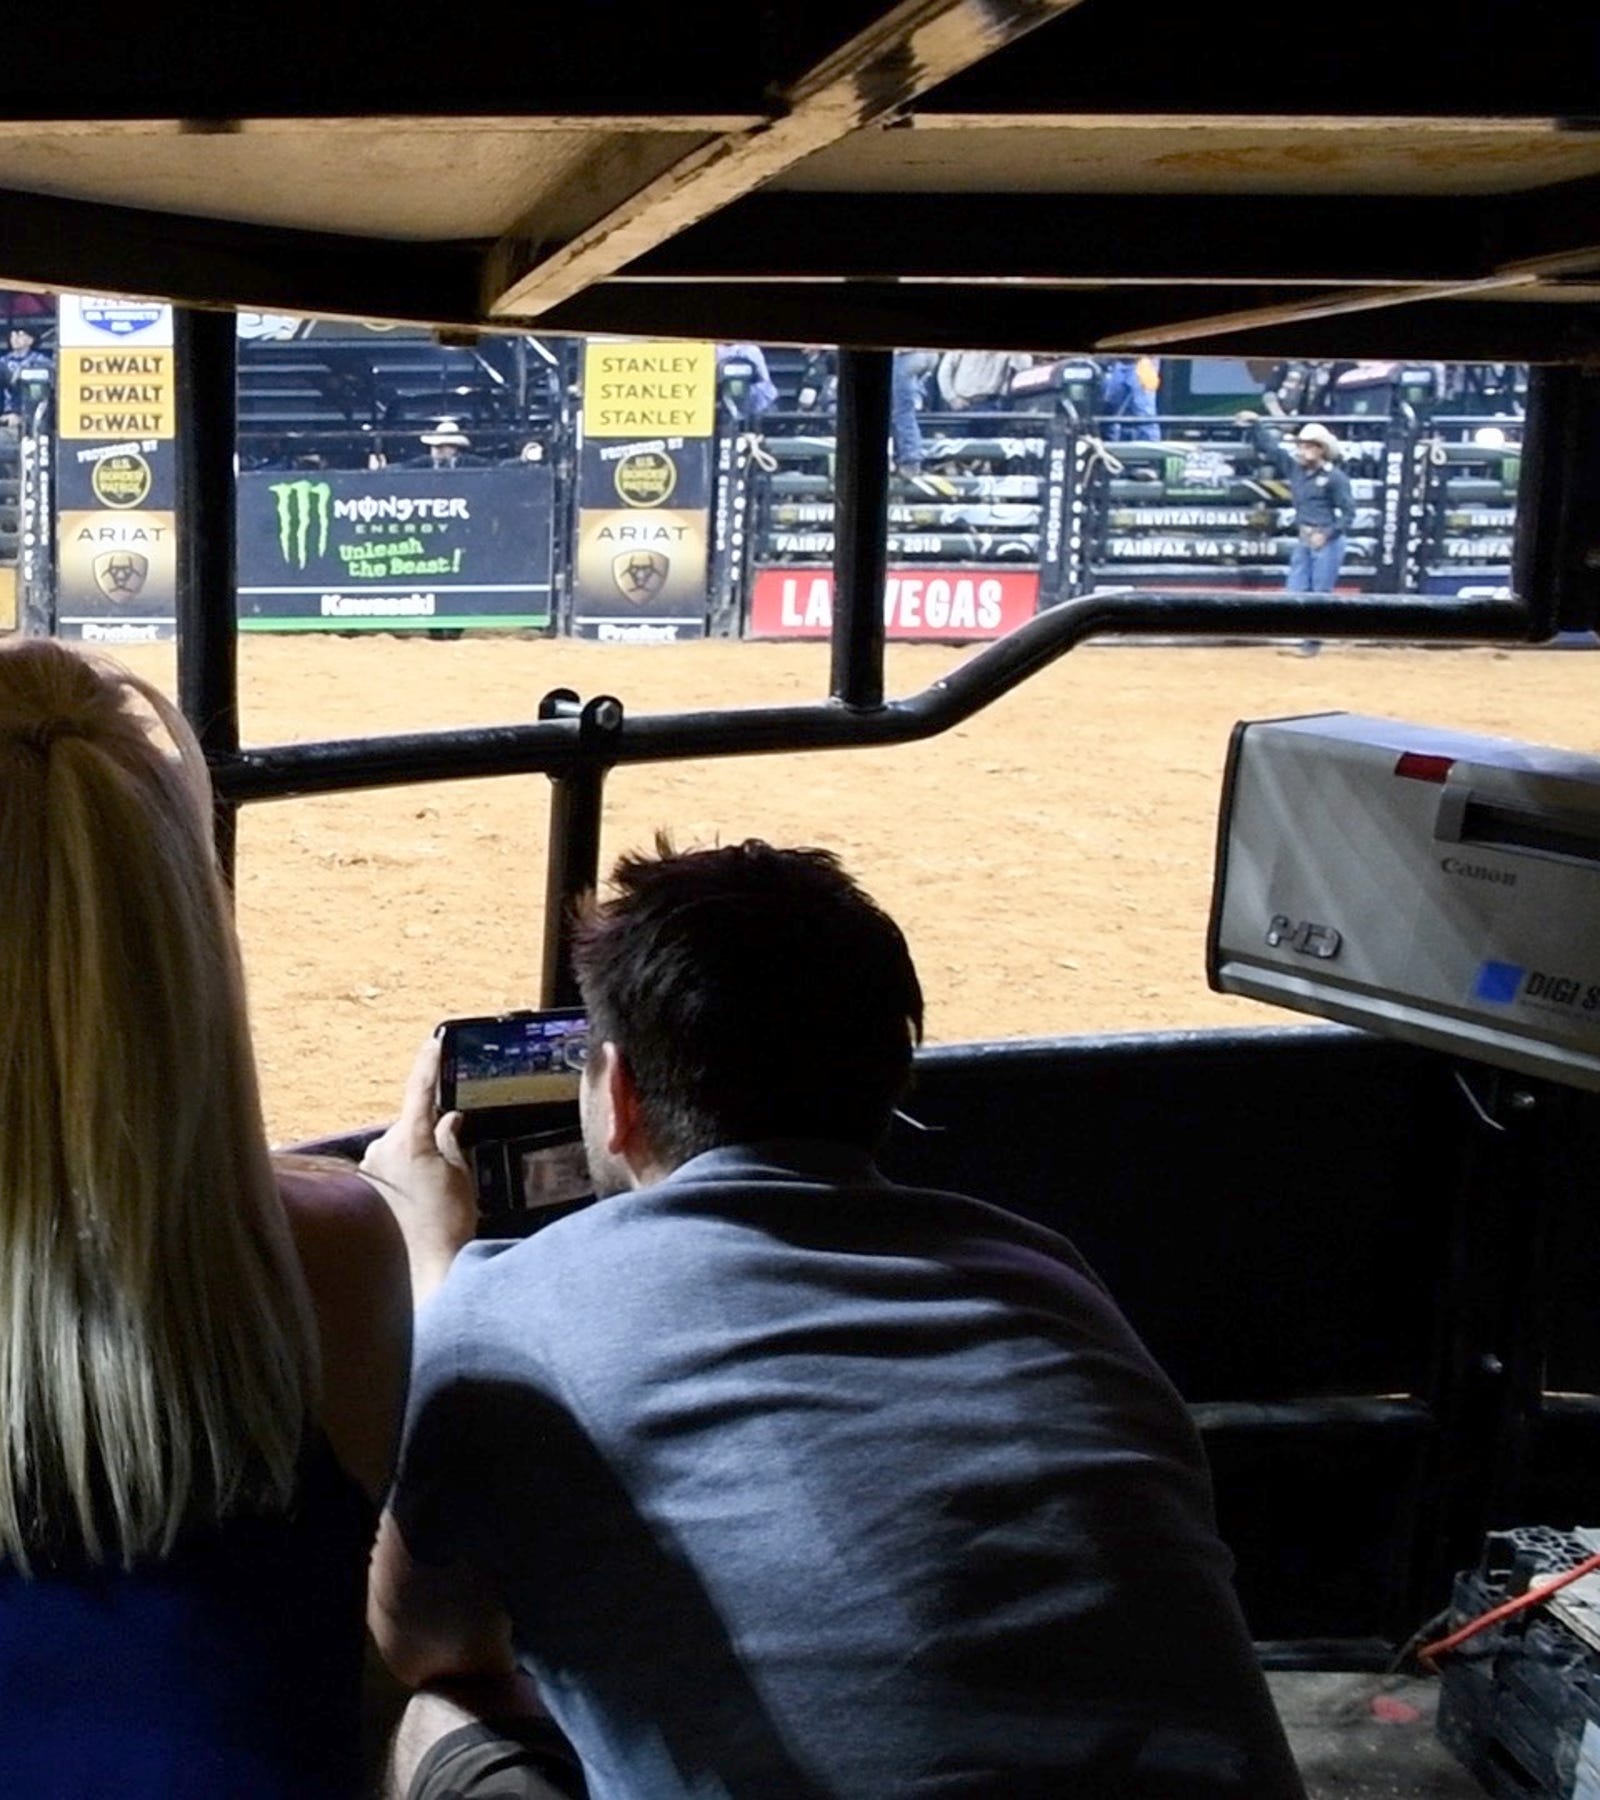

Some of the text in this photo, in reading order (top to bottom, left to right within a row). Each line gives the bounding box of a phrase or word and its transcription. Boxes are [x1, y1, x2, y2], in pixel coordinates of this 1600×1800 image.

[601, 357, 699, 374] STANLEY
[600, 383, 698, 400] STANLEY
[599, 409, 697, 426] STANLEY
[334, 495, 470, 522] MONSTER
[1135, 511, 1249, 526] INVITATIONAL
[76, 527, 167, 542] ARIAT
[355, 524, 449, 533] ENERGY
[597, 526, 691, 541] ARIAT
[339, 538, 424, 562] Unleash
[1195, 541, 1219, 556] VA
[348, 549, 463, 578] the Beast!
[321, 594, 435, 616] Kawasaki
[1441, 856, 1518, 887] Canon
[1525, 971, 1580, 1005] DIGI
